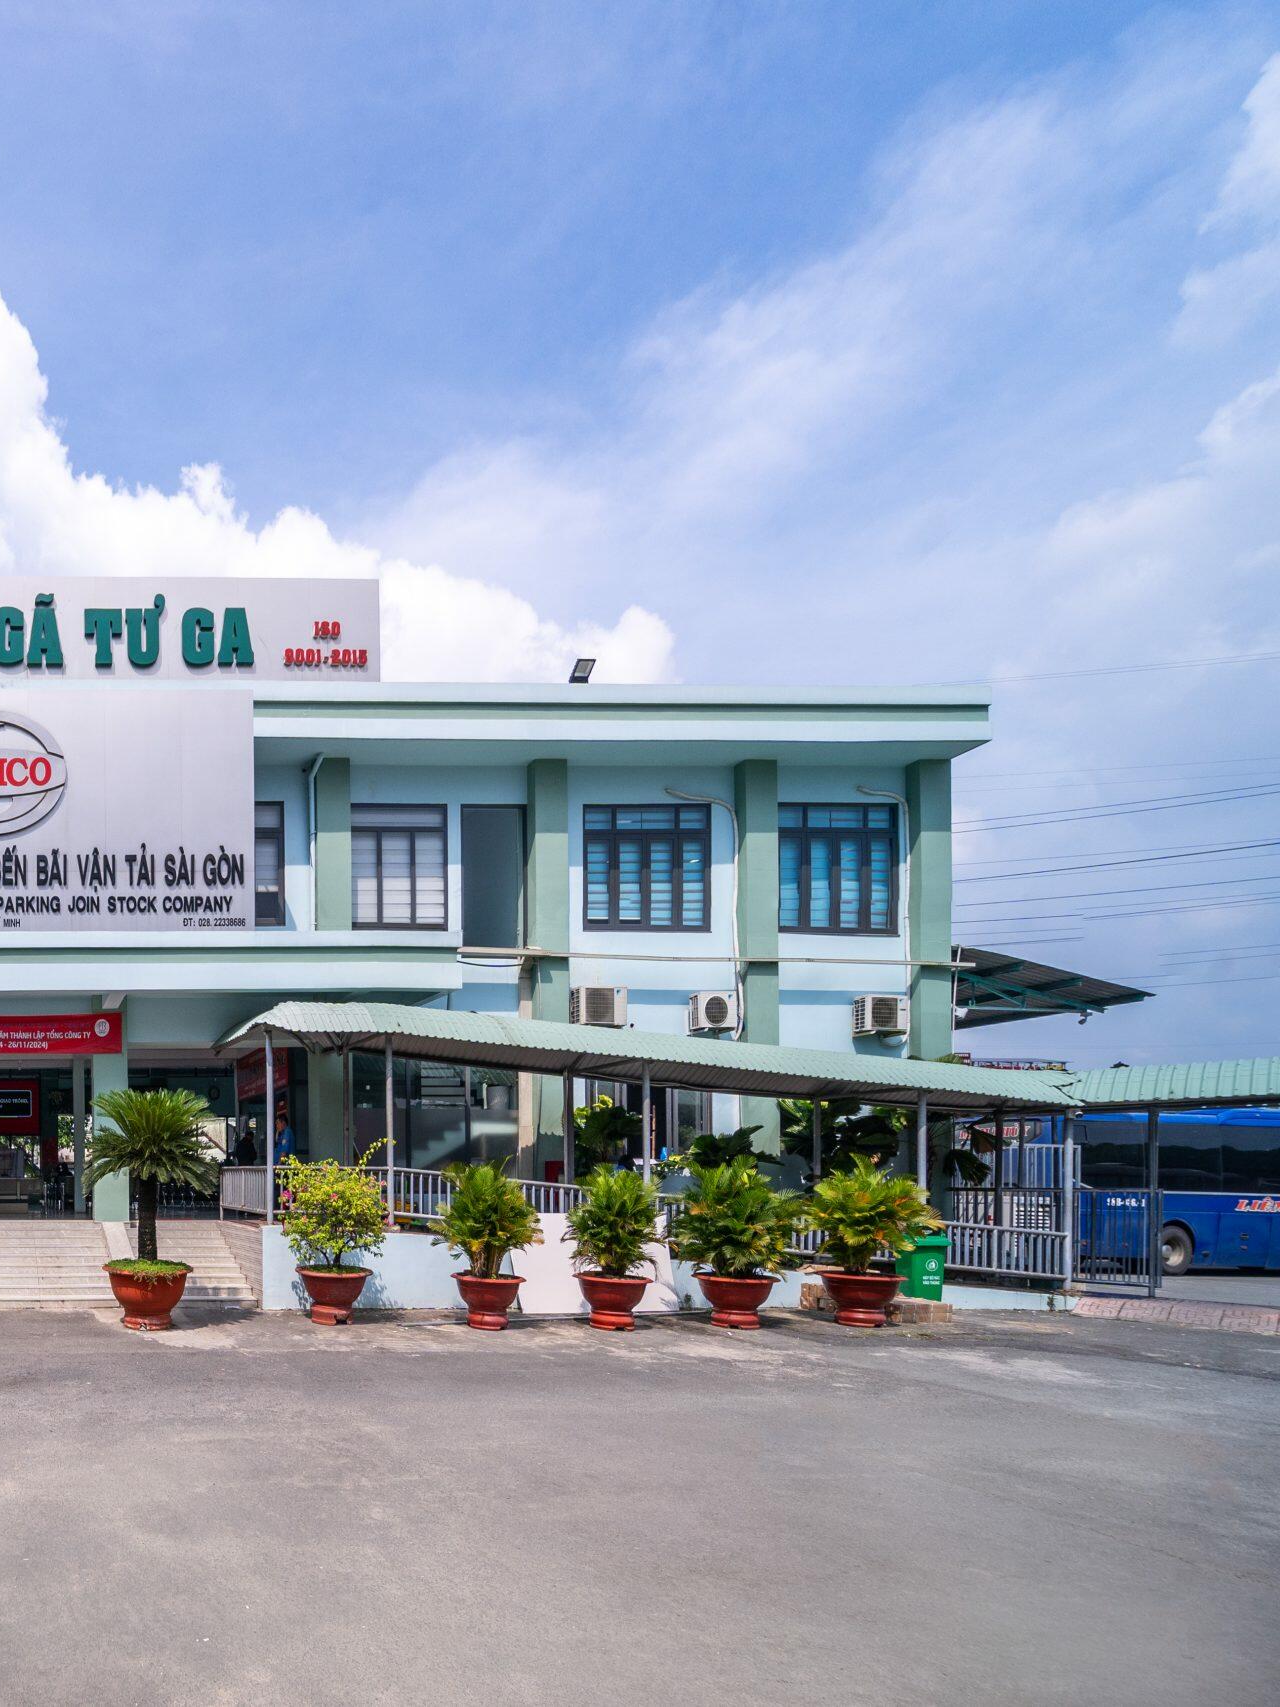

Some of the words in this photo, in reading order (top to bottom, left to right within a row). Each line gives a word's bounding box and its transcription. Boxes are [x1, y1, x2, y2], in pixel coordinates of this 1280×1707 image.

[84, 594, 165, 667] TƯ
[181, 607, 254, 667] GA
[37, 848, 67, 887] BÃI
[77, 847, 116, 893] VẬN
[125, 843, 155, 887] TẢI
[164, 846, 195, 887] SÀI
[203, 846, 244, 887] GÒN
[68, 896, 100, 914] JOIN
[107, 896, 157, 914] STOCK
[163, 896, 232, 914] COMPANY
[4, 918, 21, 928] MINH
[198, 918, 212, 928] 028.
[214, 918, 246, 928] 22338686
